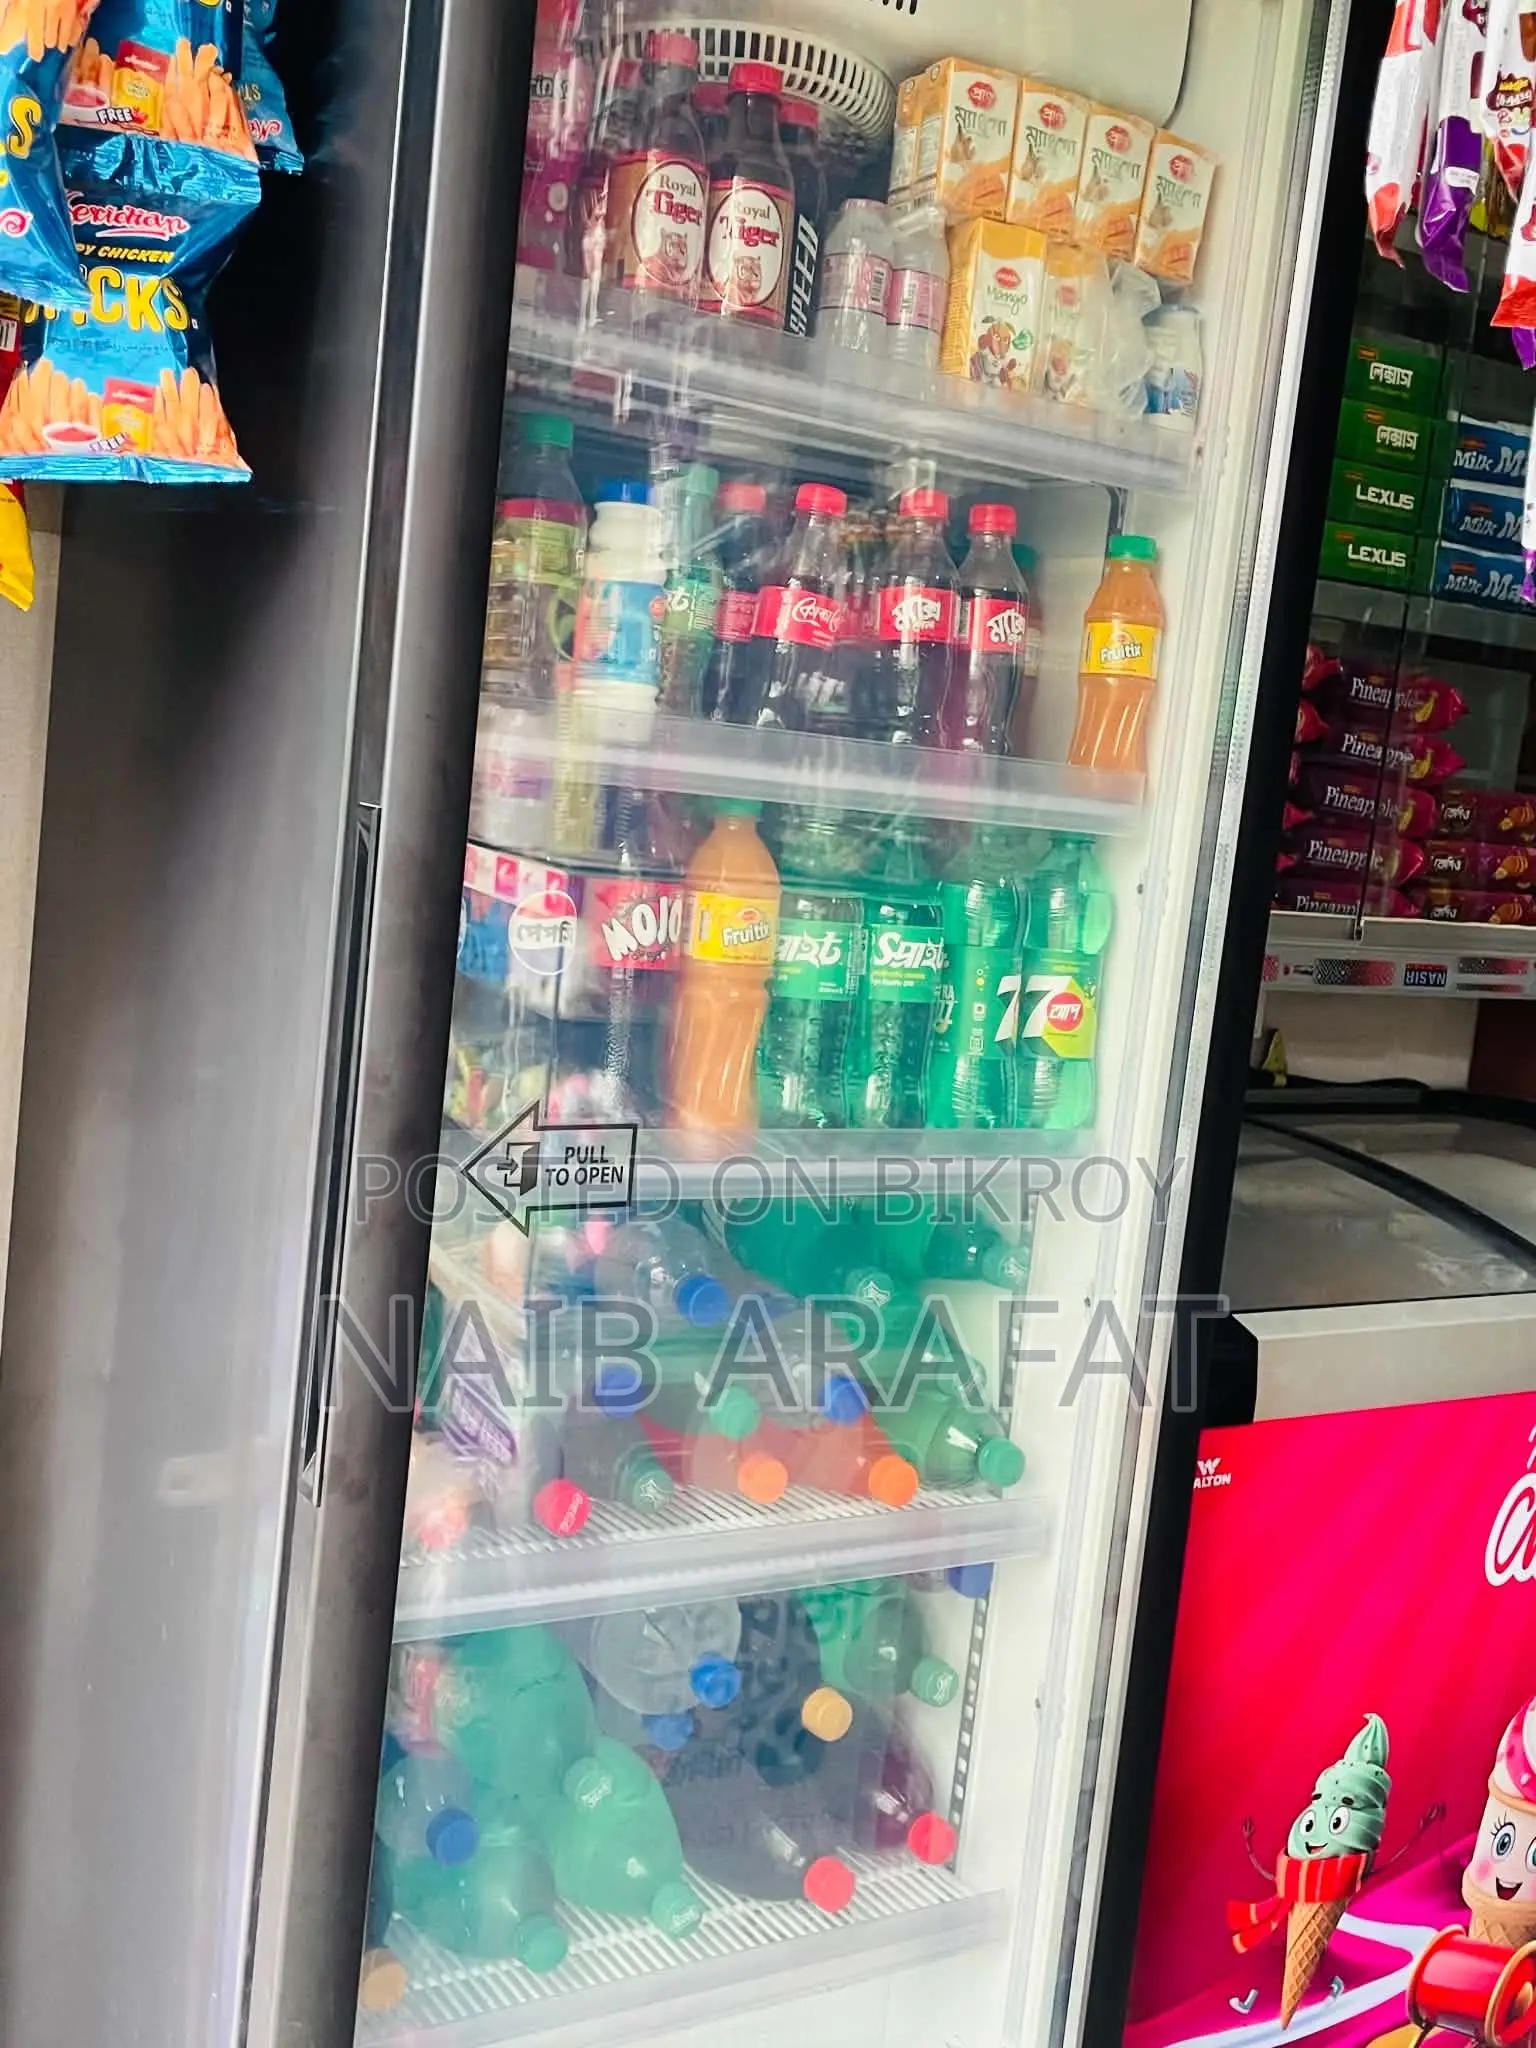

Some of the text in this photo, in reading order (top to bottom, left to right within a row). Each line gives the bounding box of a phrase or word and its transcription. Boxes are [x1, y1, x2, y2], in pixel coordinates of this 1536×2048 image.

[97, 107, 134, 125] FREE
[659, 173, 697, 197] Royal
[72, 200, 190, 238] eridian
[645, 189, 703, 226] Tiger
[719, 215, 780, 248] Tiger
[97, 245, 175, 263] CHICKEN
[1453, 449, 1494, 472] Milk
[1356, 484, 1414, 509] LEXUS
[1460, 515, 1497, 536] Milk
[1348, 544, 1406, 567] LEXUS
[1444, 574, 1482, 595] Milk
[1341, 733, 1415, 768] Pineapple
[1325, 785, 1400, 819] Pineapple
[1307, 839, 1384, 871] Pineapple
[601, 896, 684, 961] MOJO
[993, 975, 1021, 1041] 7
[1021, 975, 1073, 1039] 7
[564, 1145, 609, 1165] PULL
[545, 1165, 624, 1187] TO OPEN
[1193, 1472, 1232, 1489] ALTON
